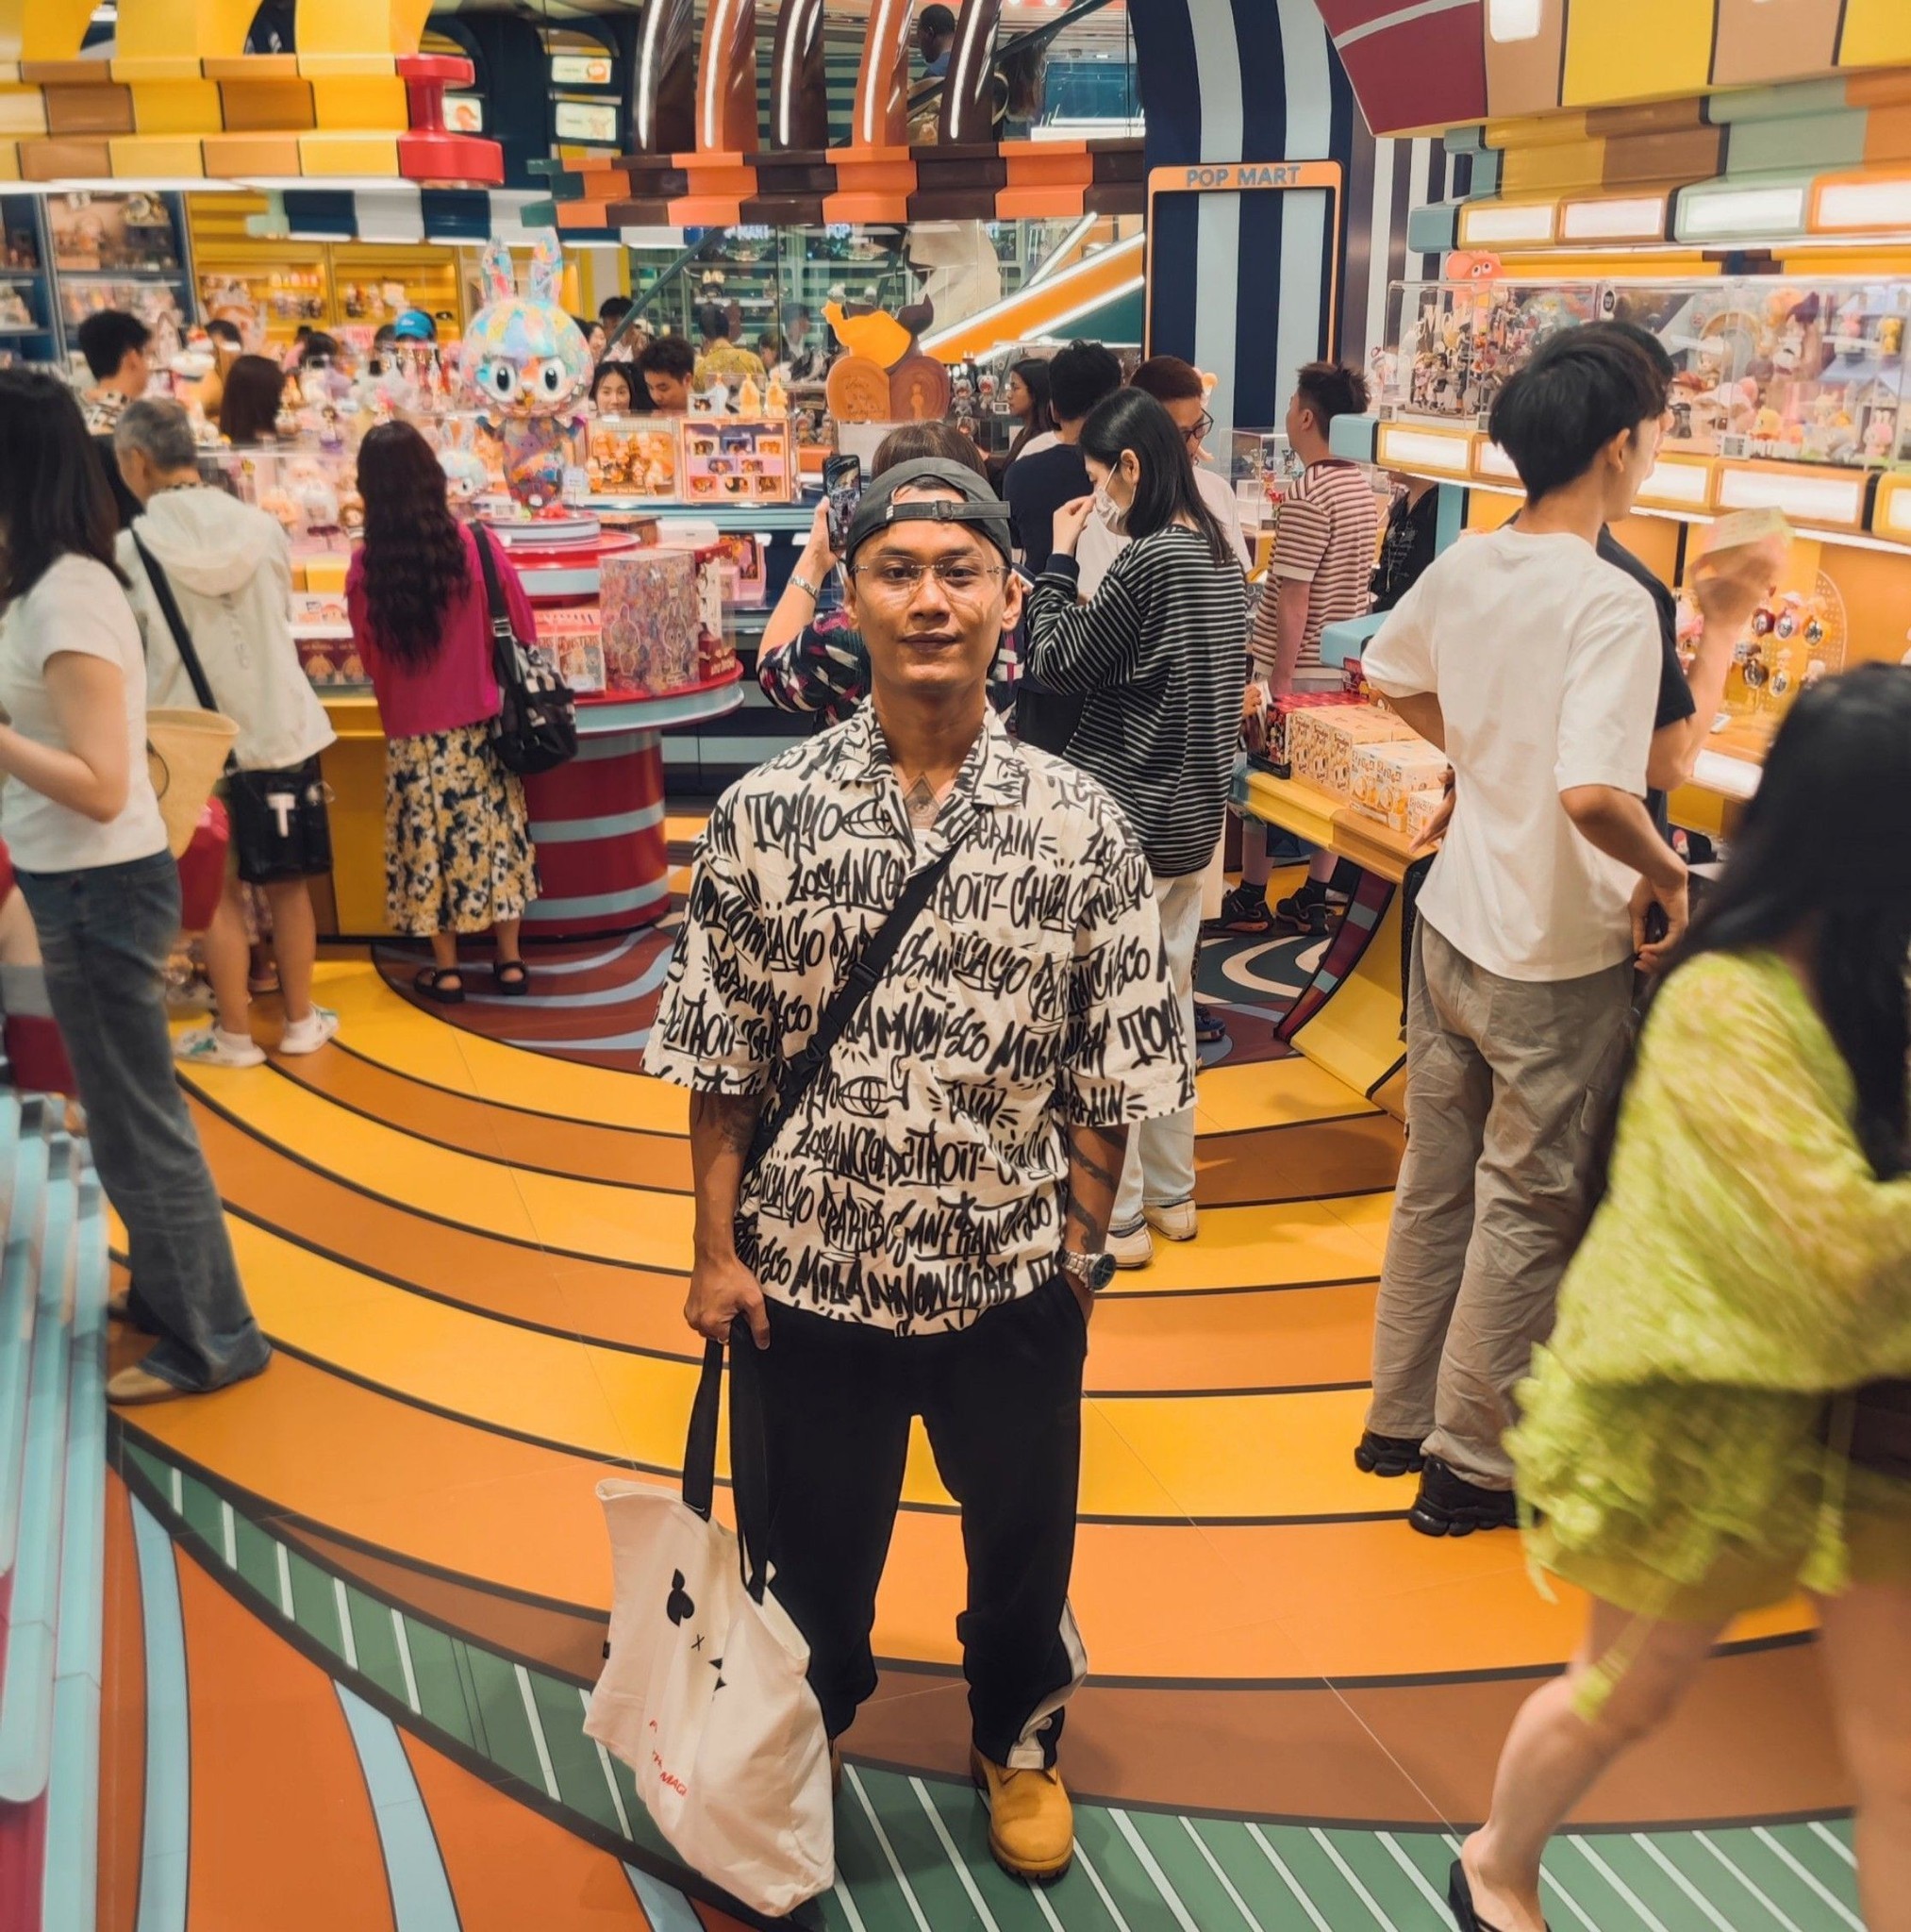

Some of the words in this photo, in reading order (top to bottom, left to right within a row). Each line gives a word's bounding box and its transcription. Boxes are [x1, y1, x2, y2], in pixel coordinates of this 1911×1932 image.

[1187, 169, 1228, 187] POP
[1238, 166, 1301, 186] MART
[267, 792, 295, 838] T
[744, 782, 844, 862] TOKYO
[950, 1253, 1020, 1328] YORK
